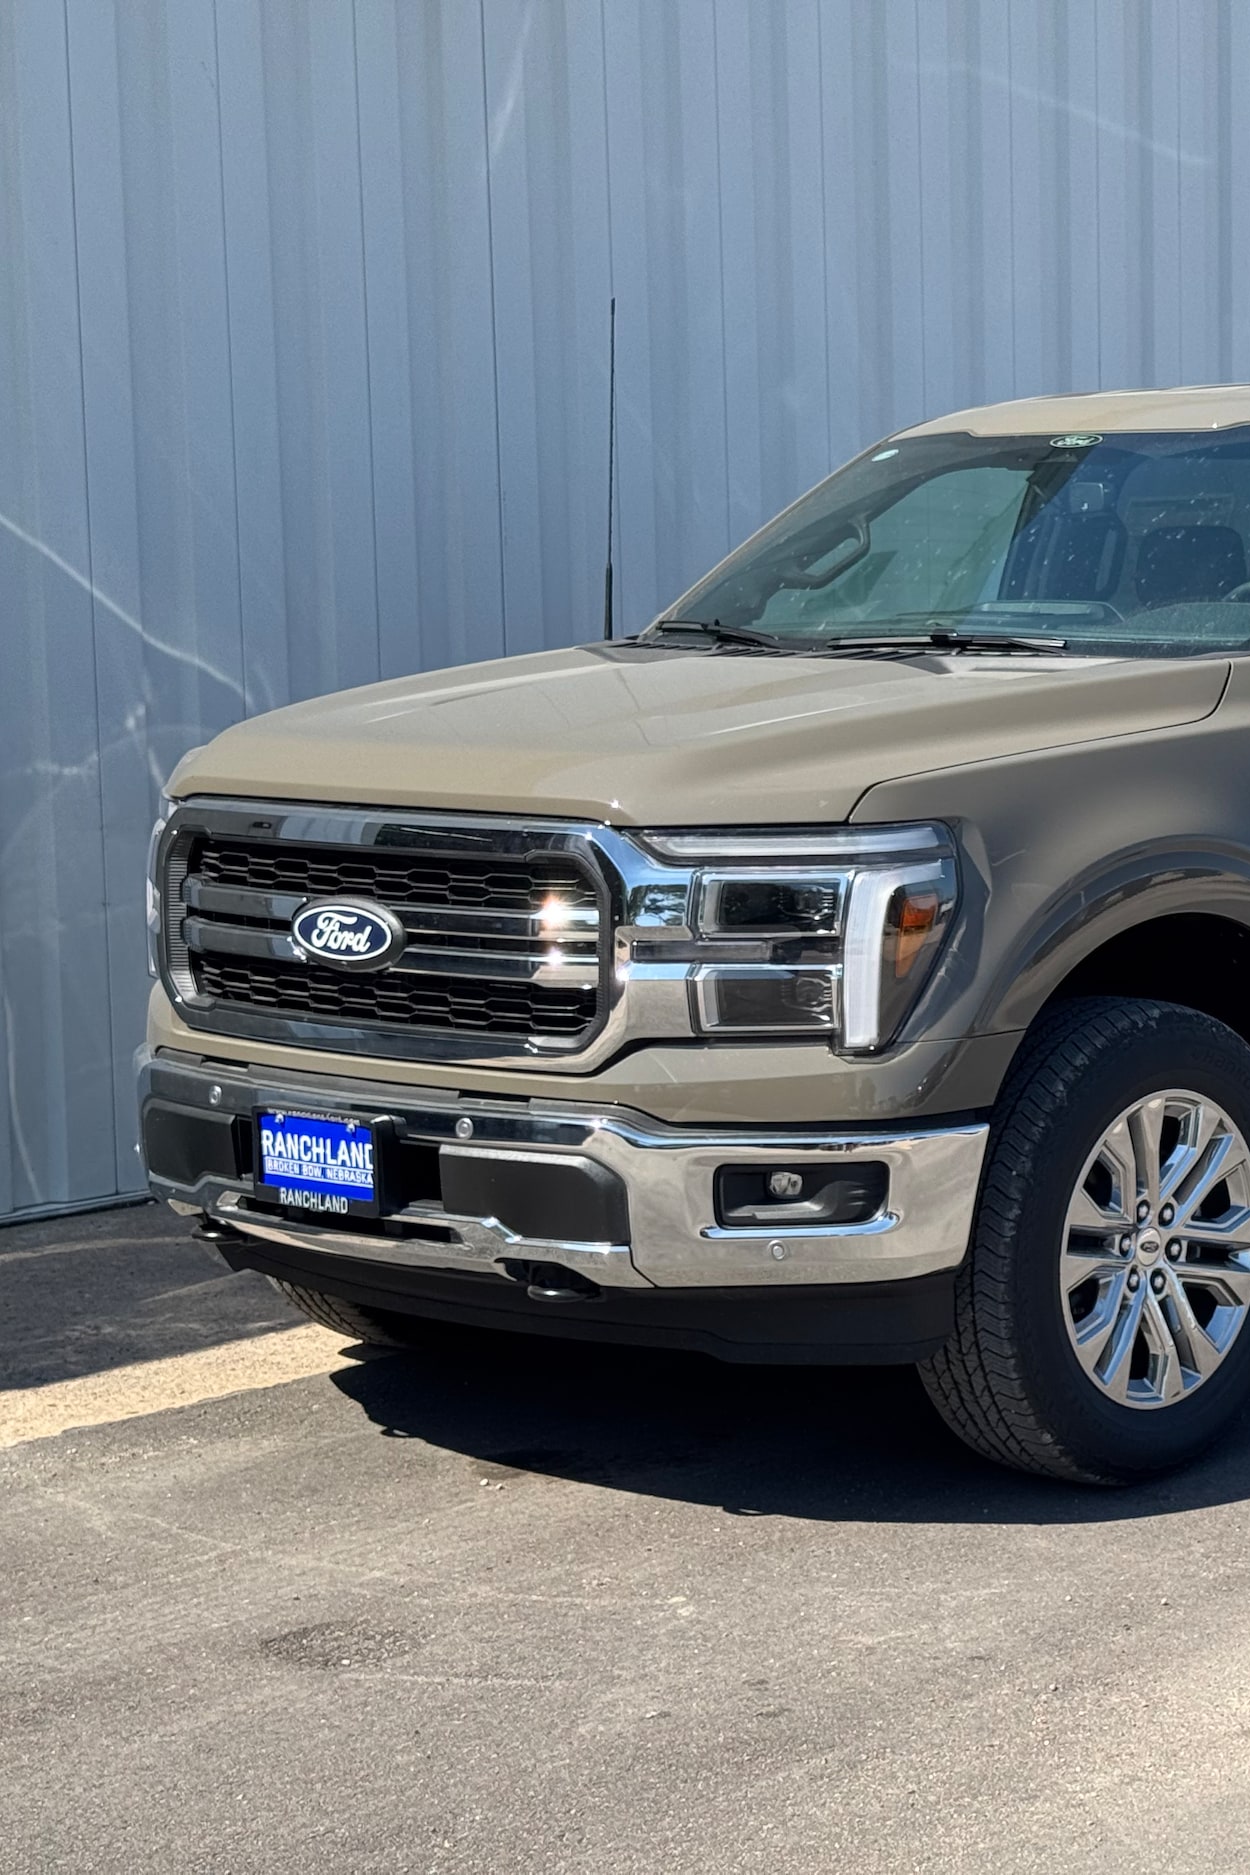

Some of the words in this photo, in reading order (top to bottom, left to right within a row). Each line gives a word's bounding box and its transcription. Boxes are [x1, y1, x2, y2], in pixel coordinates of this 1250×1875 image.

[311, 912, 372, 952] Ford
[267, 1158, 299, 1174] BROKEN
[327, 1168, 374, 1185] NEBRASKA
[280, 1187, 349, 1214] RANCHLAND
